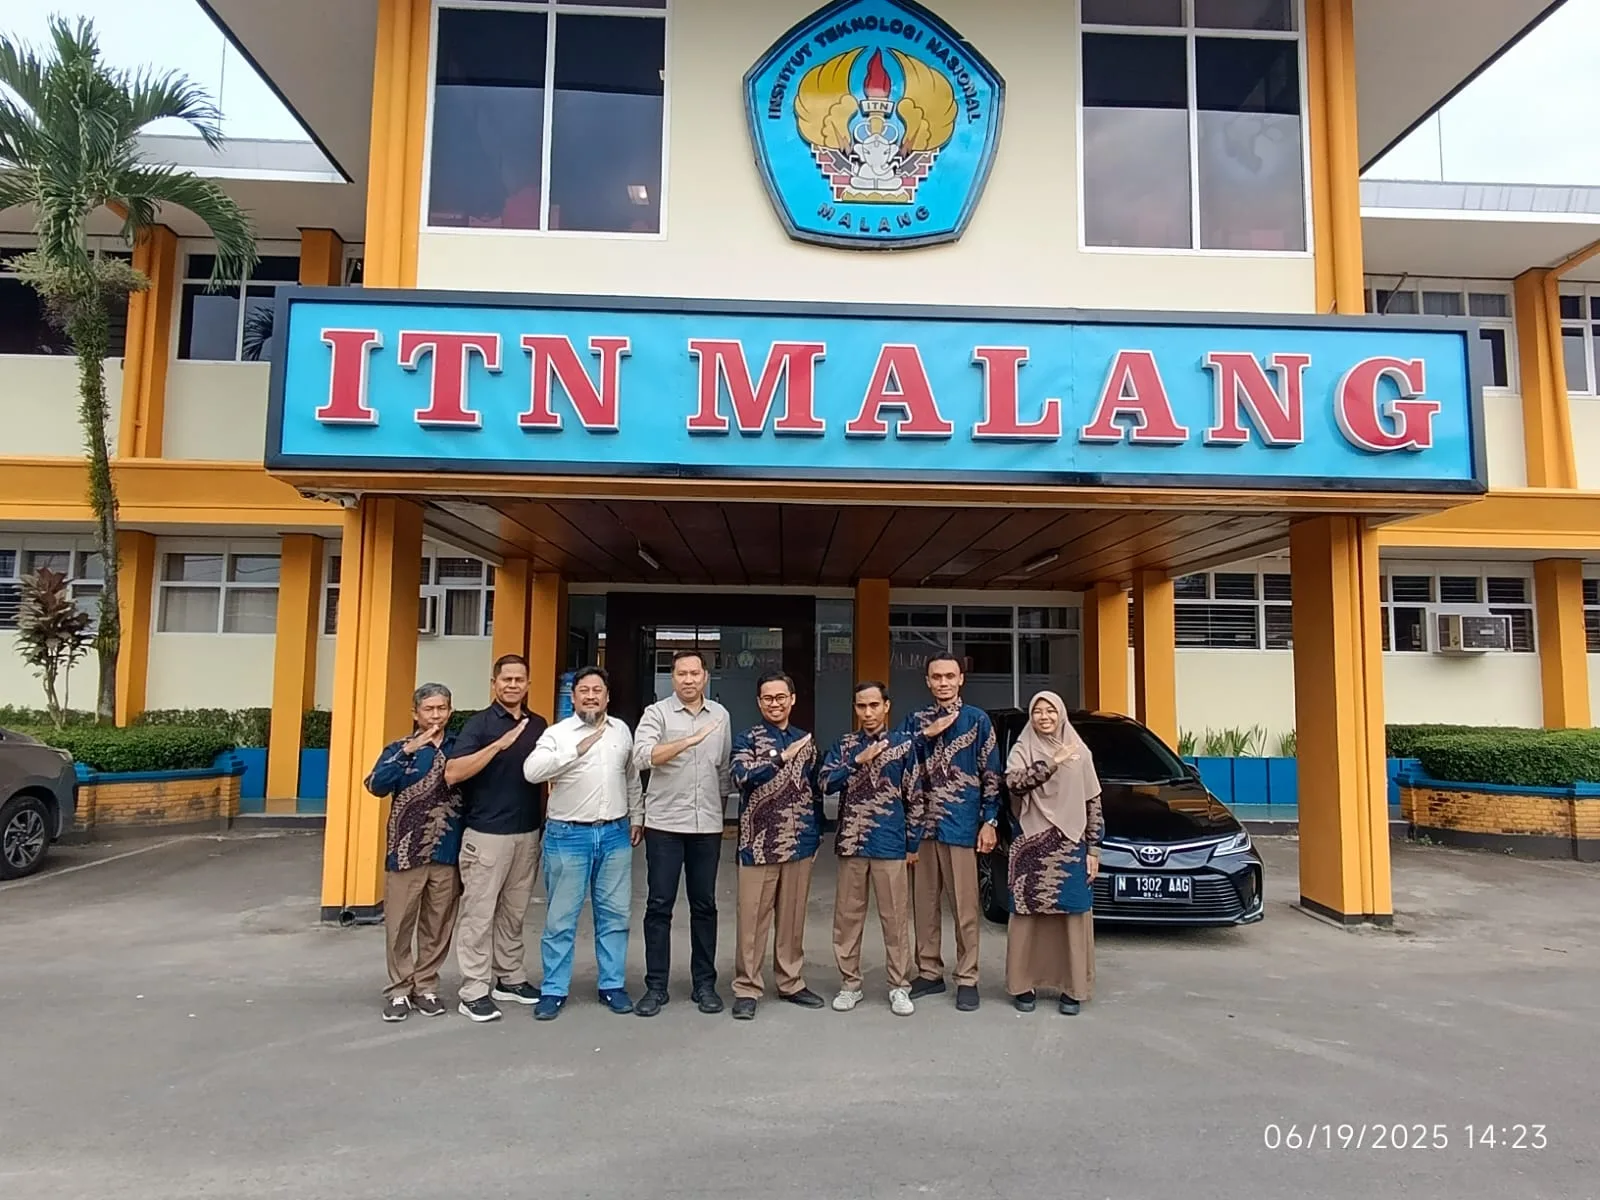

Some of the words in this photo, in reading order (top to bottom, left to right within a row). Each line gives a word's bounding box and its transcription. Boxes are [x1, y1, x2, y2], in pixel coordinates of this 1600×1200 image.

[767, 45, 814, 120] INSTITUT
[814, 14, 925, 48] TEKNOLOGI
[927, 36, 982, 125] NASIONAL
[866, 101, 890, 111] ITN
[816, 202, 930, 233] MALANG
[314, 328, 631, 432] ITN
[686, 337, 1441, 453] MALANG
[1118, 877, 1126, 891] N
[1136, 878, 1162, 892] 1302
[1168, 878, 1189, 892] AAG
